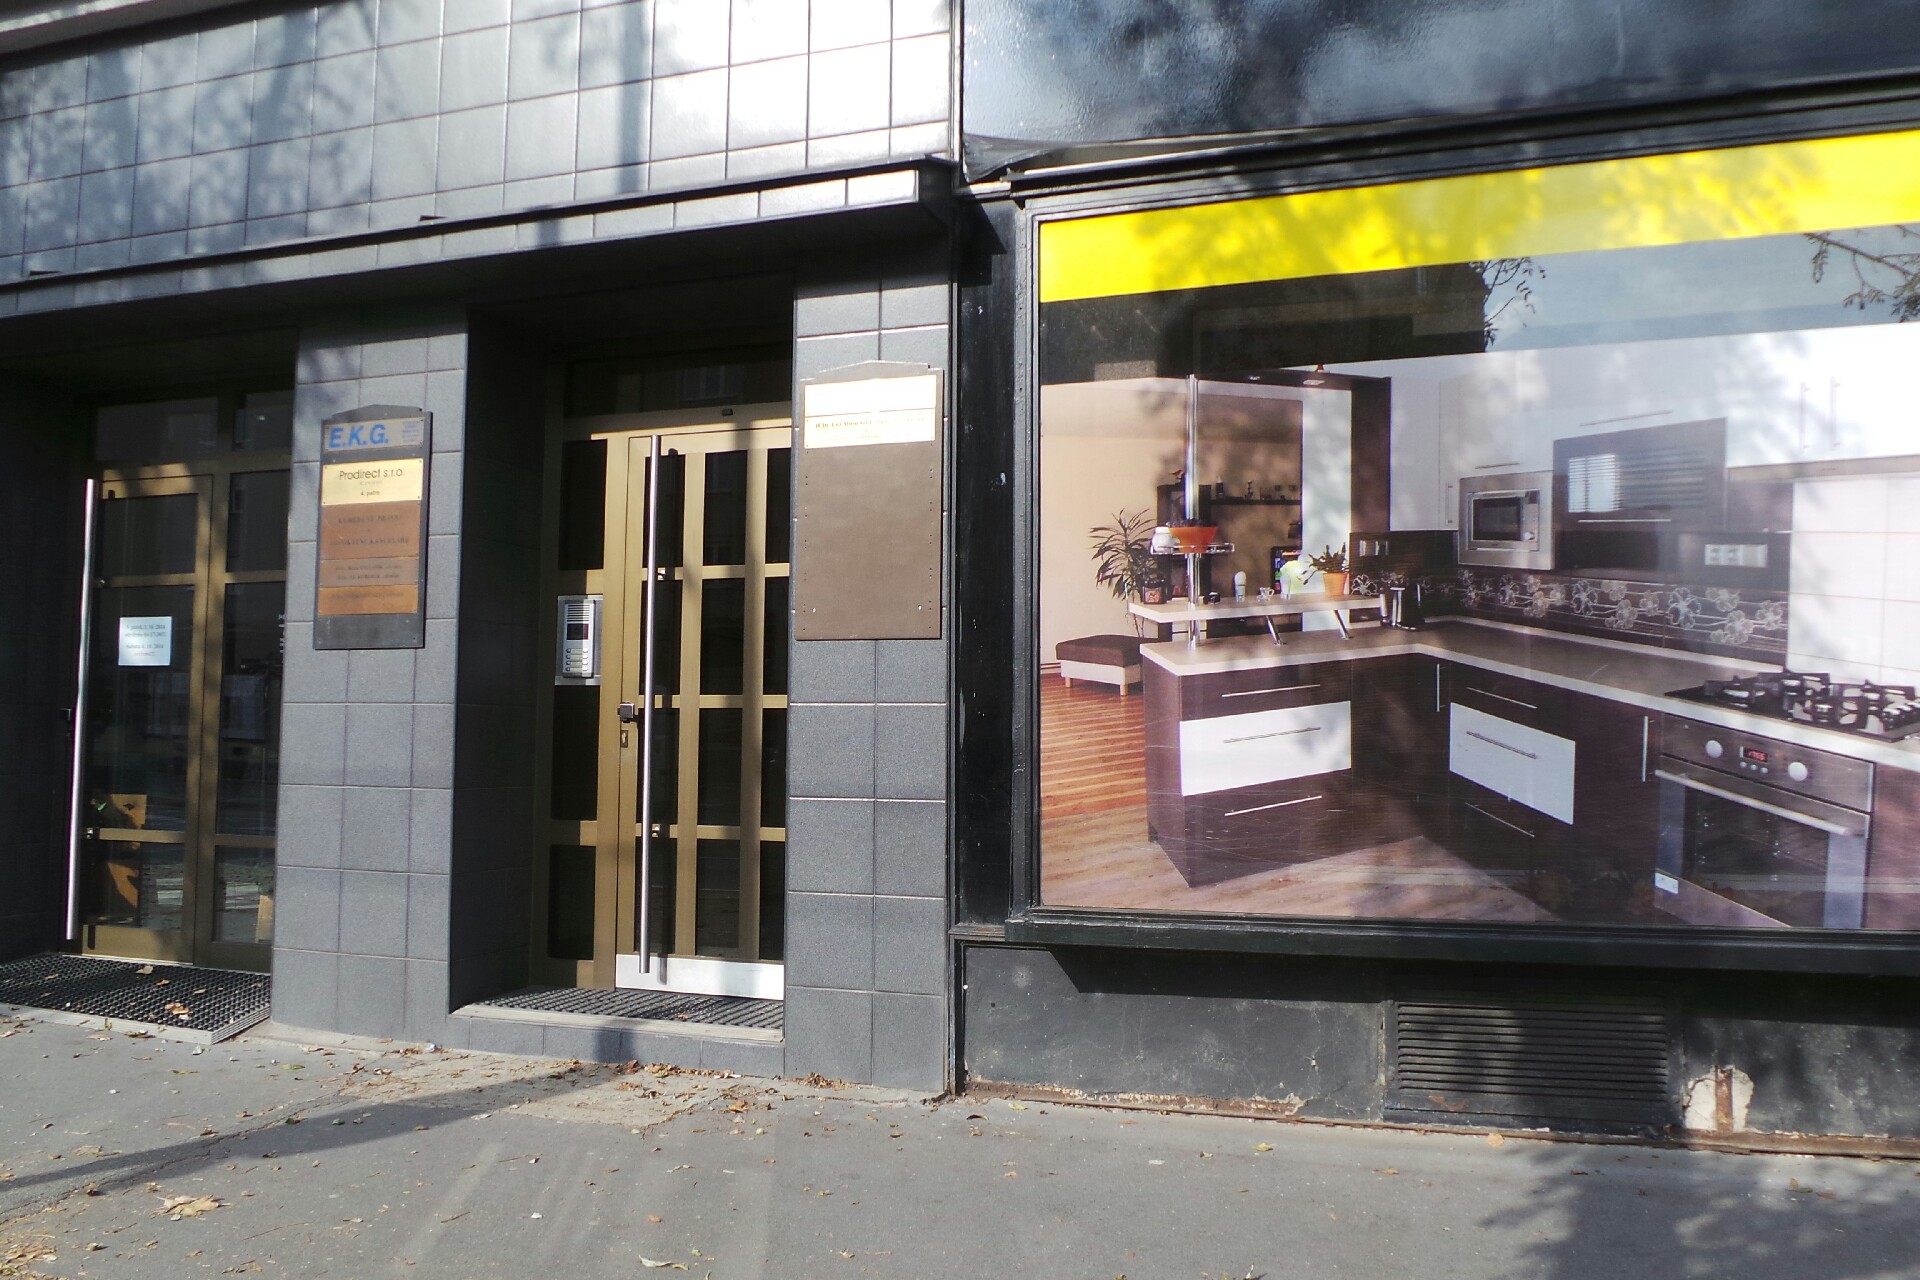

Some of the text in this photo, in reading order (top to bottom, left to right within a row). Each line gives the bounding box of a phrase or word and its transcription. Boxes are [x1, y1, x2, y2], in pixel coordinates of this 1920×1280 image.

[329, 423, 389, 448] E.K.G.
[338, 468, 405, 480] Prodirect s.r.o.
